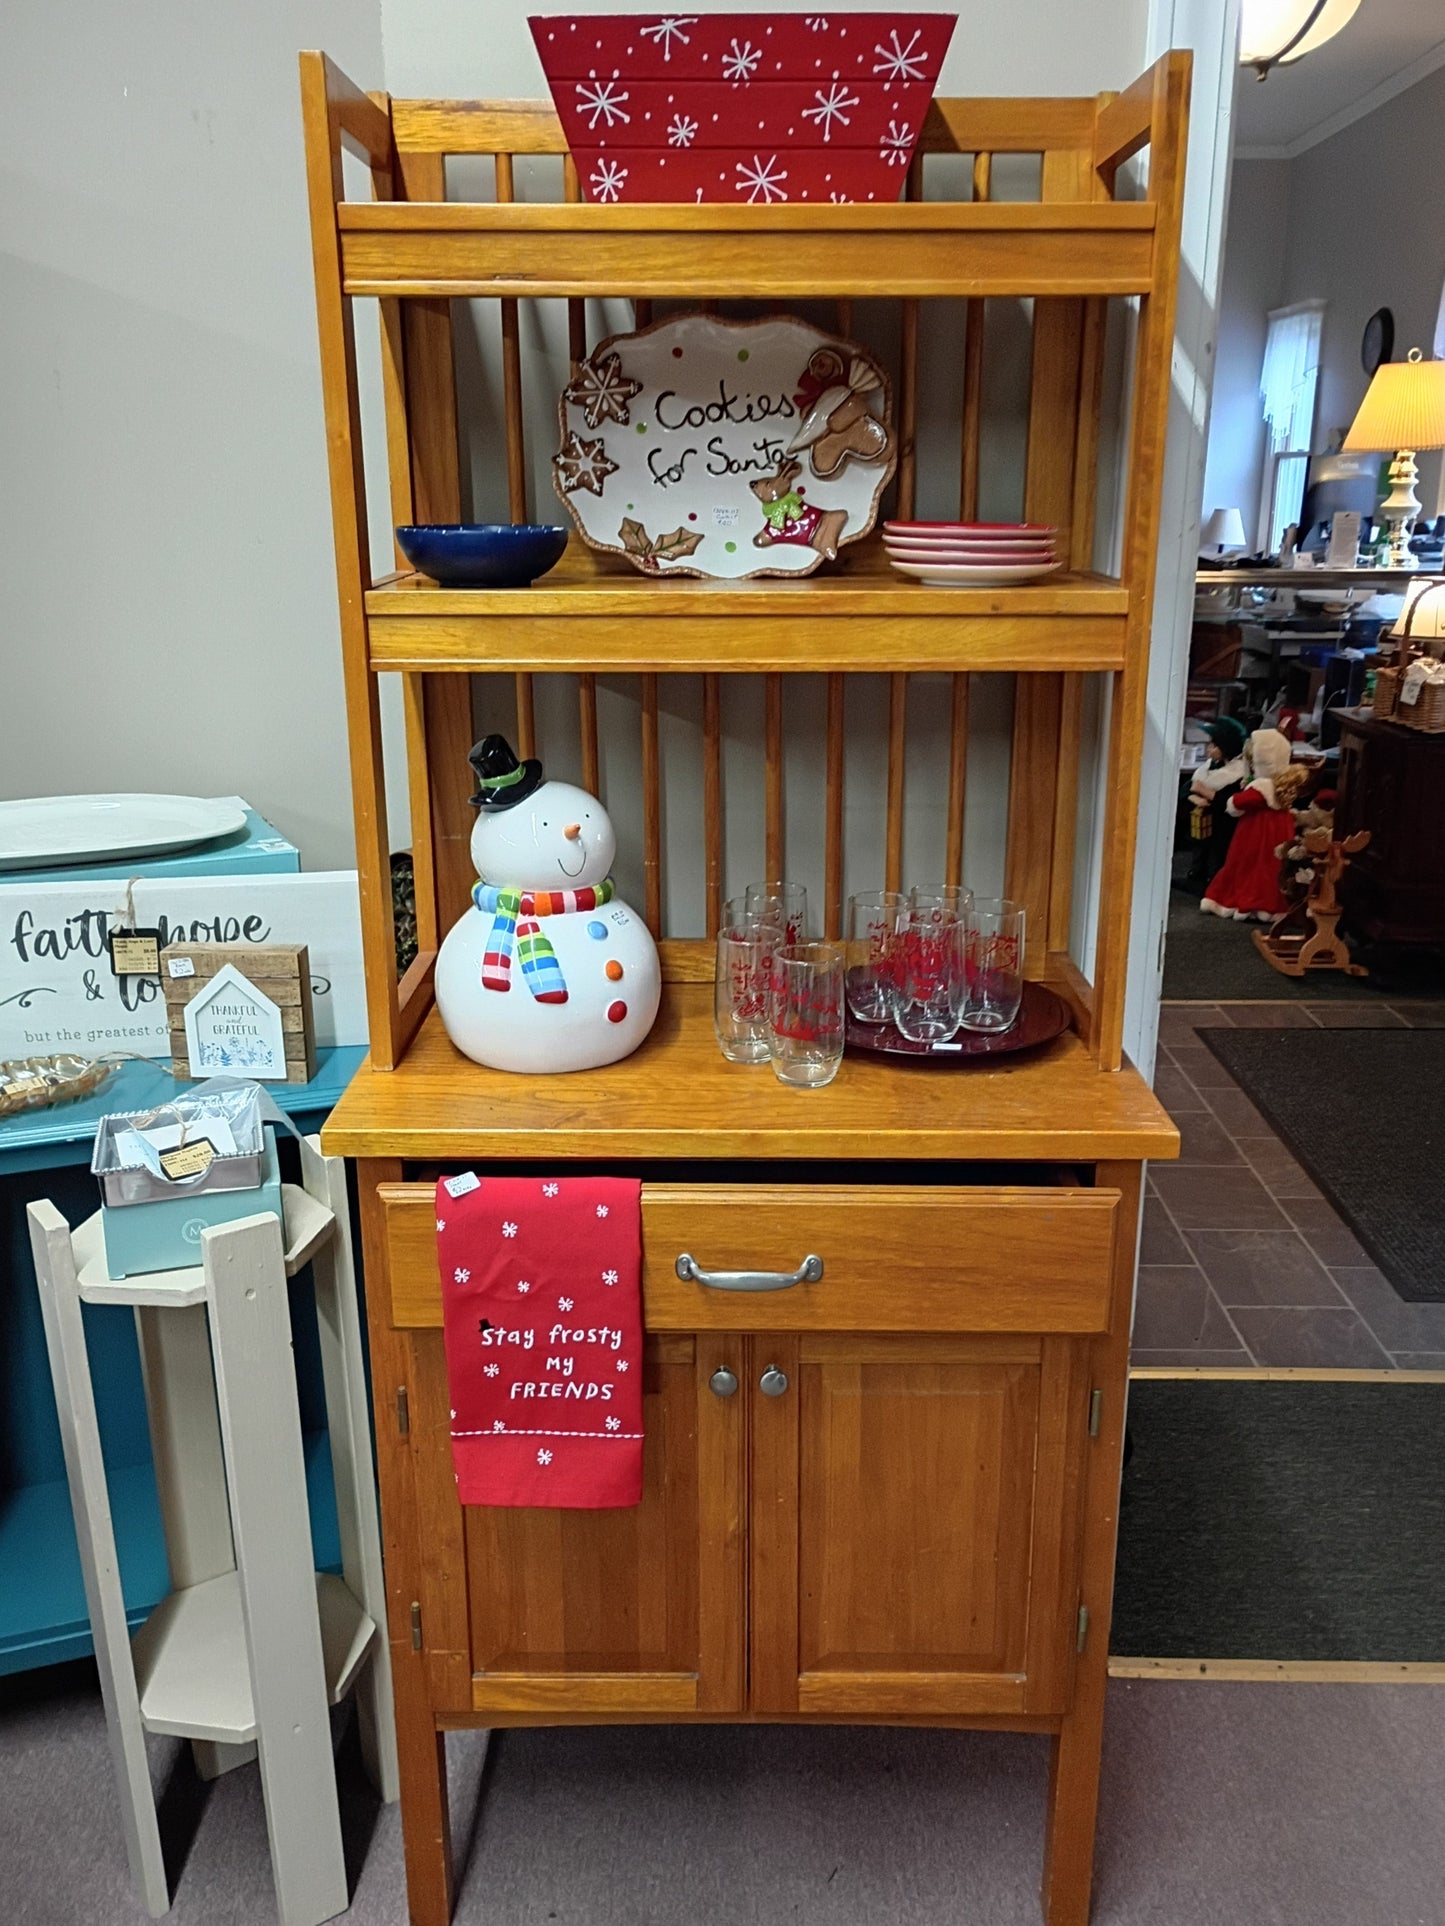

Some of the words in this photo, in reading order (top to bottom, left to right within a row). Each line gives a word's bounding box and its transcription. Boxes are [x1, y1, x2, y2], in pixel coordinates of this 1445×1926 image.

[654, 378, 796, 431] Cookies
[647, 447, 699, 489] for
[706, 436, 799, 476] Santa
[157, 914, 272, 944] hope
[82, 968, 105, 1001] &
[210, 1004, 259, 1017] THANKFUL
[225, 1015, 243, 1024] and
[23, 1030, 52, 1043] but
[56, 1027, 82, 1041] the
[87, 1025, 151, 1043] greatest
[212, 1023, 261, 1036] GRATEFUL
[481, 1326, 535, 1350] Stay
[548, 1323, 623, 1351] frosty
[509, 1381, 615, 1401] FRIENDS
